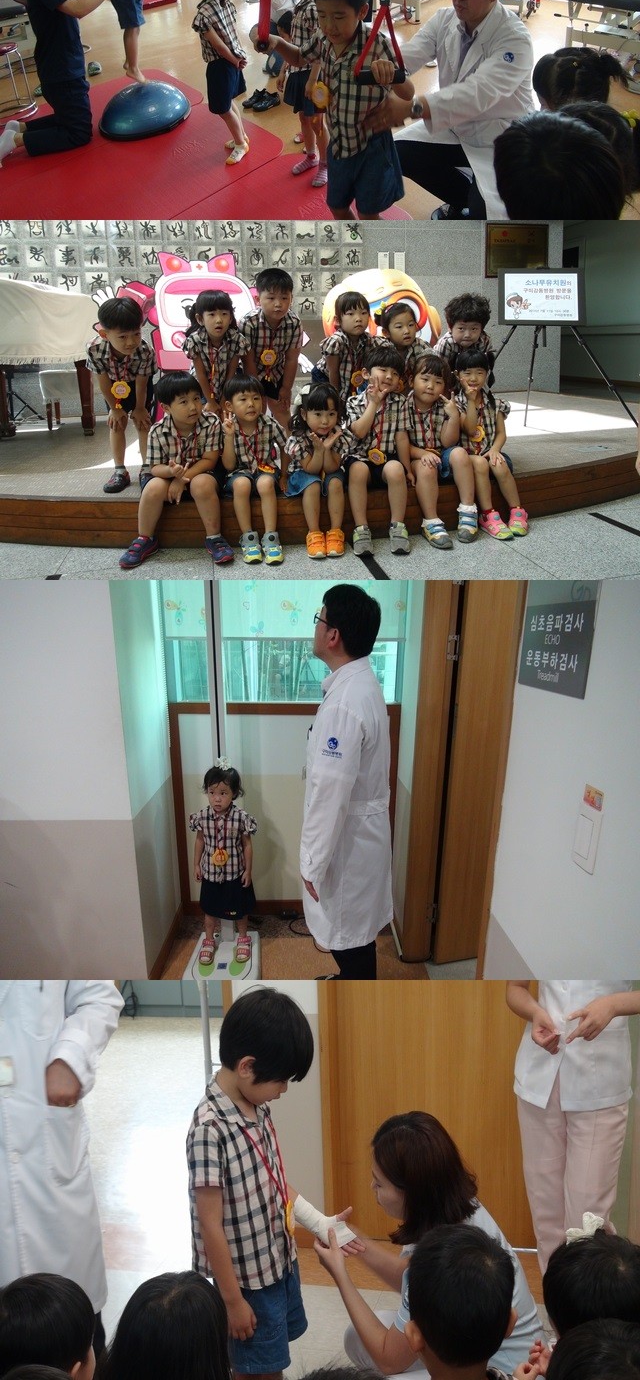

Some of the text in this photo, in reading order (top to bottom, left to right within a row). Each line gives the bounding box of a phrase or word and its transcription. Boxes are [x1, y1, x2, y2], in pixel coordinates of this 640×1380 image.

[525, 279, 572, 287] 소나무유치원의
[530, 612, 584, 632] 심초음파검사
[544, 634, 561, 646] ECHO
[526, 649, 578, 673] 운동부하검사
[537, 669, 559, 683] Treadmill
